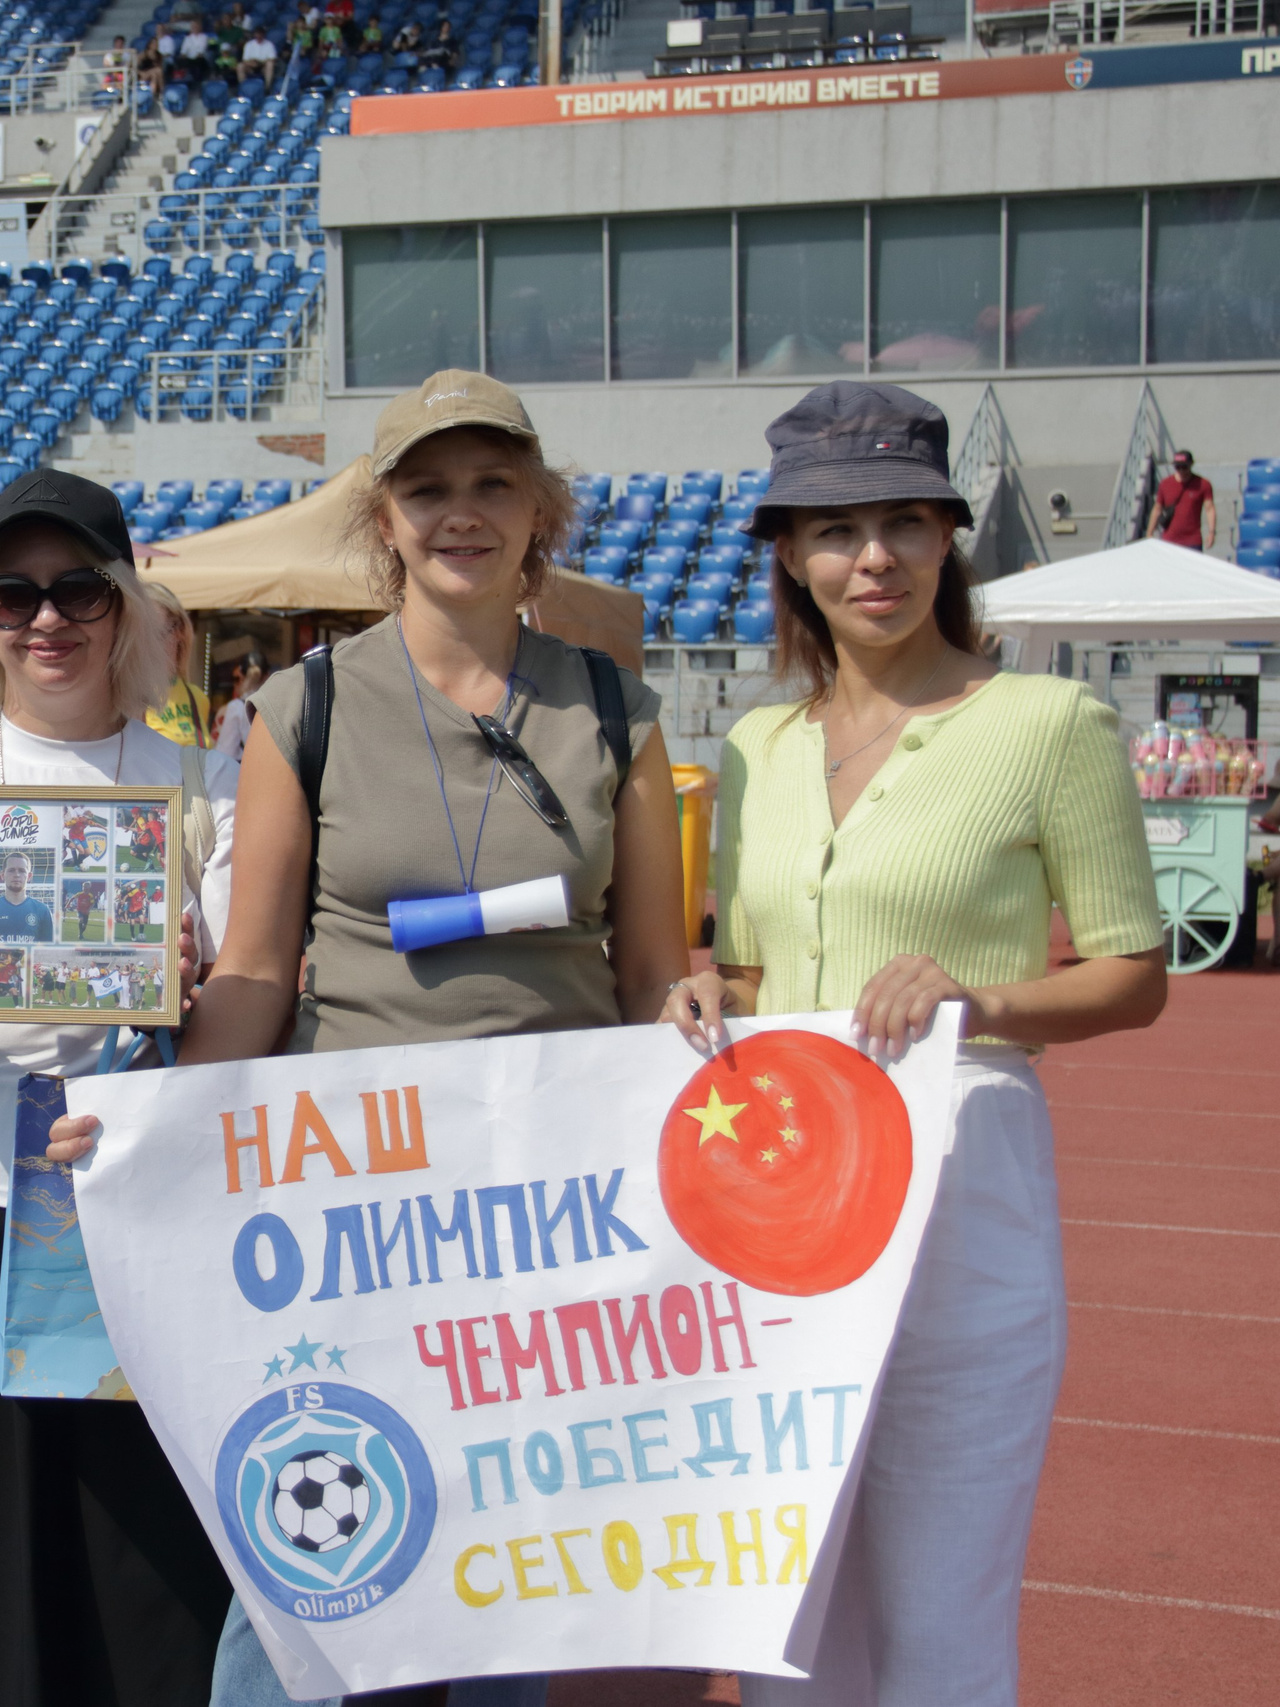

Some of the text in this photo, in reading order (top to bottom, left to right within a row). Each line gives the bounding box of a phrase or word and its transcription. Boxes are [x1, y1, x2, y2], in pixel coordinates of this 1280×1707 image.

[556, 71, 940, 117] ТВОРИМ ИСТОРИЮ ВМЕСТЕ
[0, 825, 39, 842] JUNIOR
[220, 1085, 430, 1194] НАШ
[233, 1168, 649, 1312] ОЛИМПИК
[286, 1385, 324, 1412] FS
[461, 1384, 862, 1512] ПОБЕДИТ
[453, 1503, 810, 1608] СЕГОДНЯ
